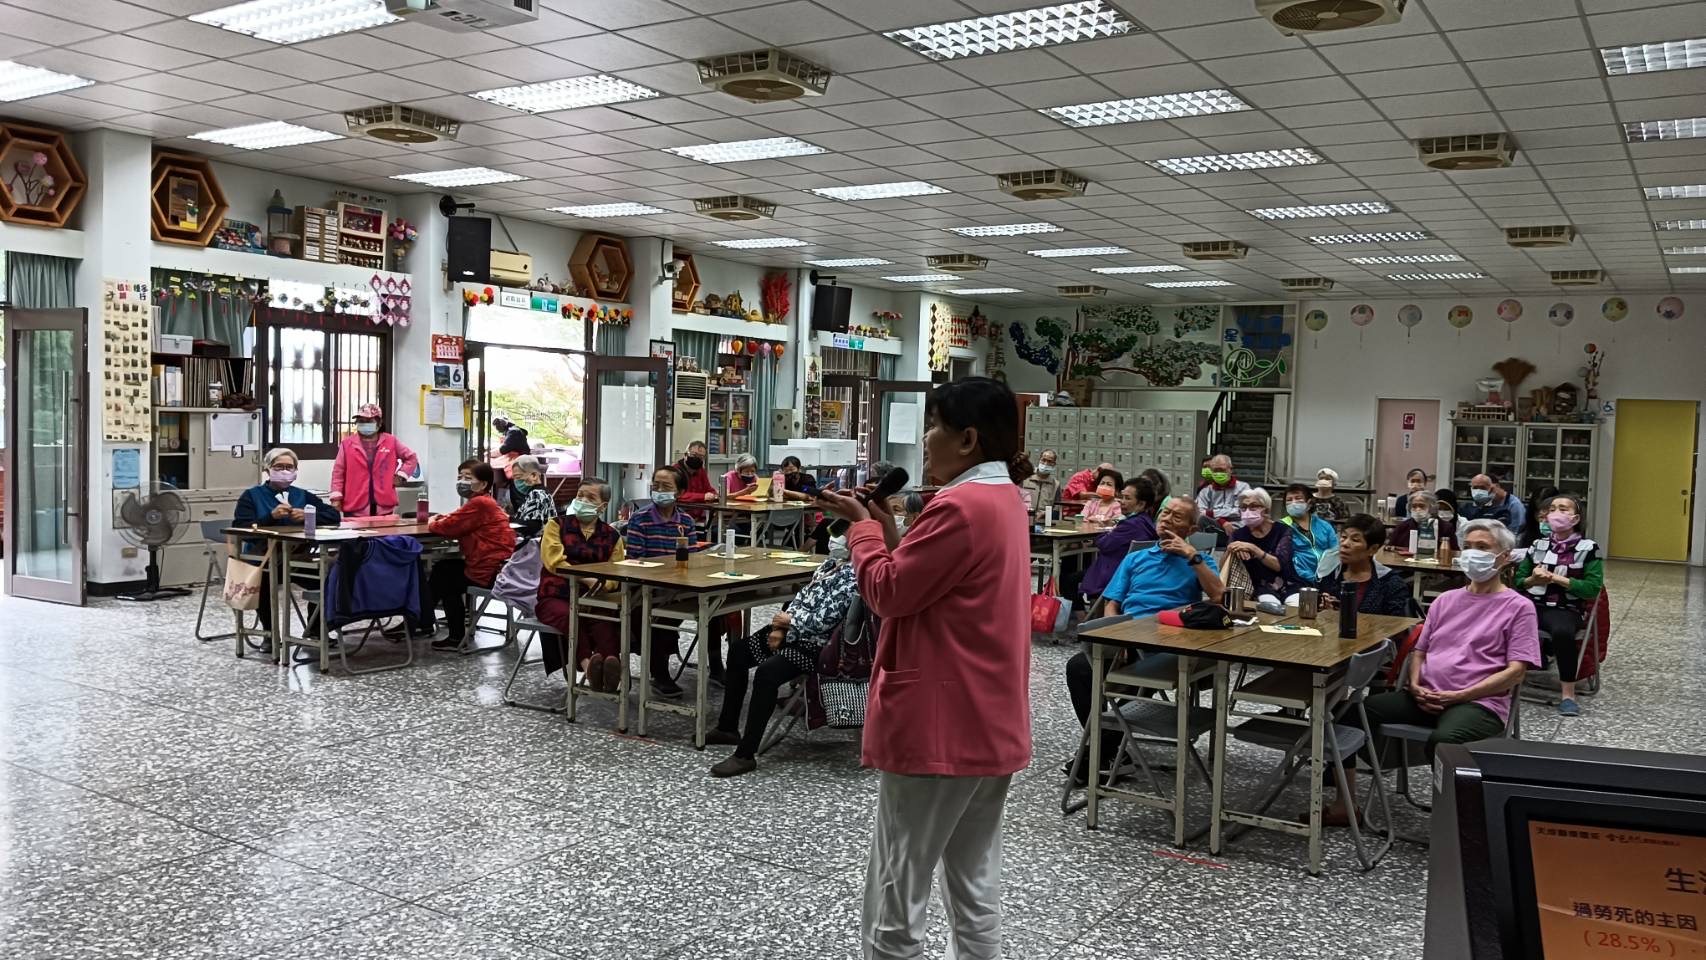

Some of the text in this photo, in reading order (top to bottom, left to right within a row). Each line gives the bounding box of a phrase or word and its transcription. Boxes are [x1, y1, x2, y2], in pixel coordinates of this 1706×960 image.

[453, 368, 461, 382] 6
[1573, 902, 1698, 931] 過勞死的主因
